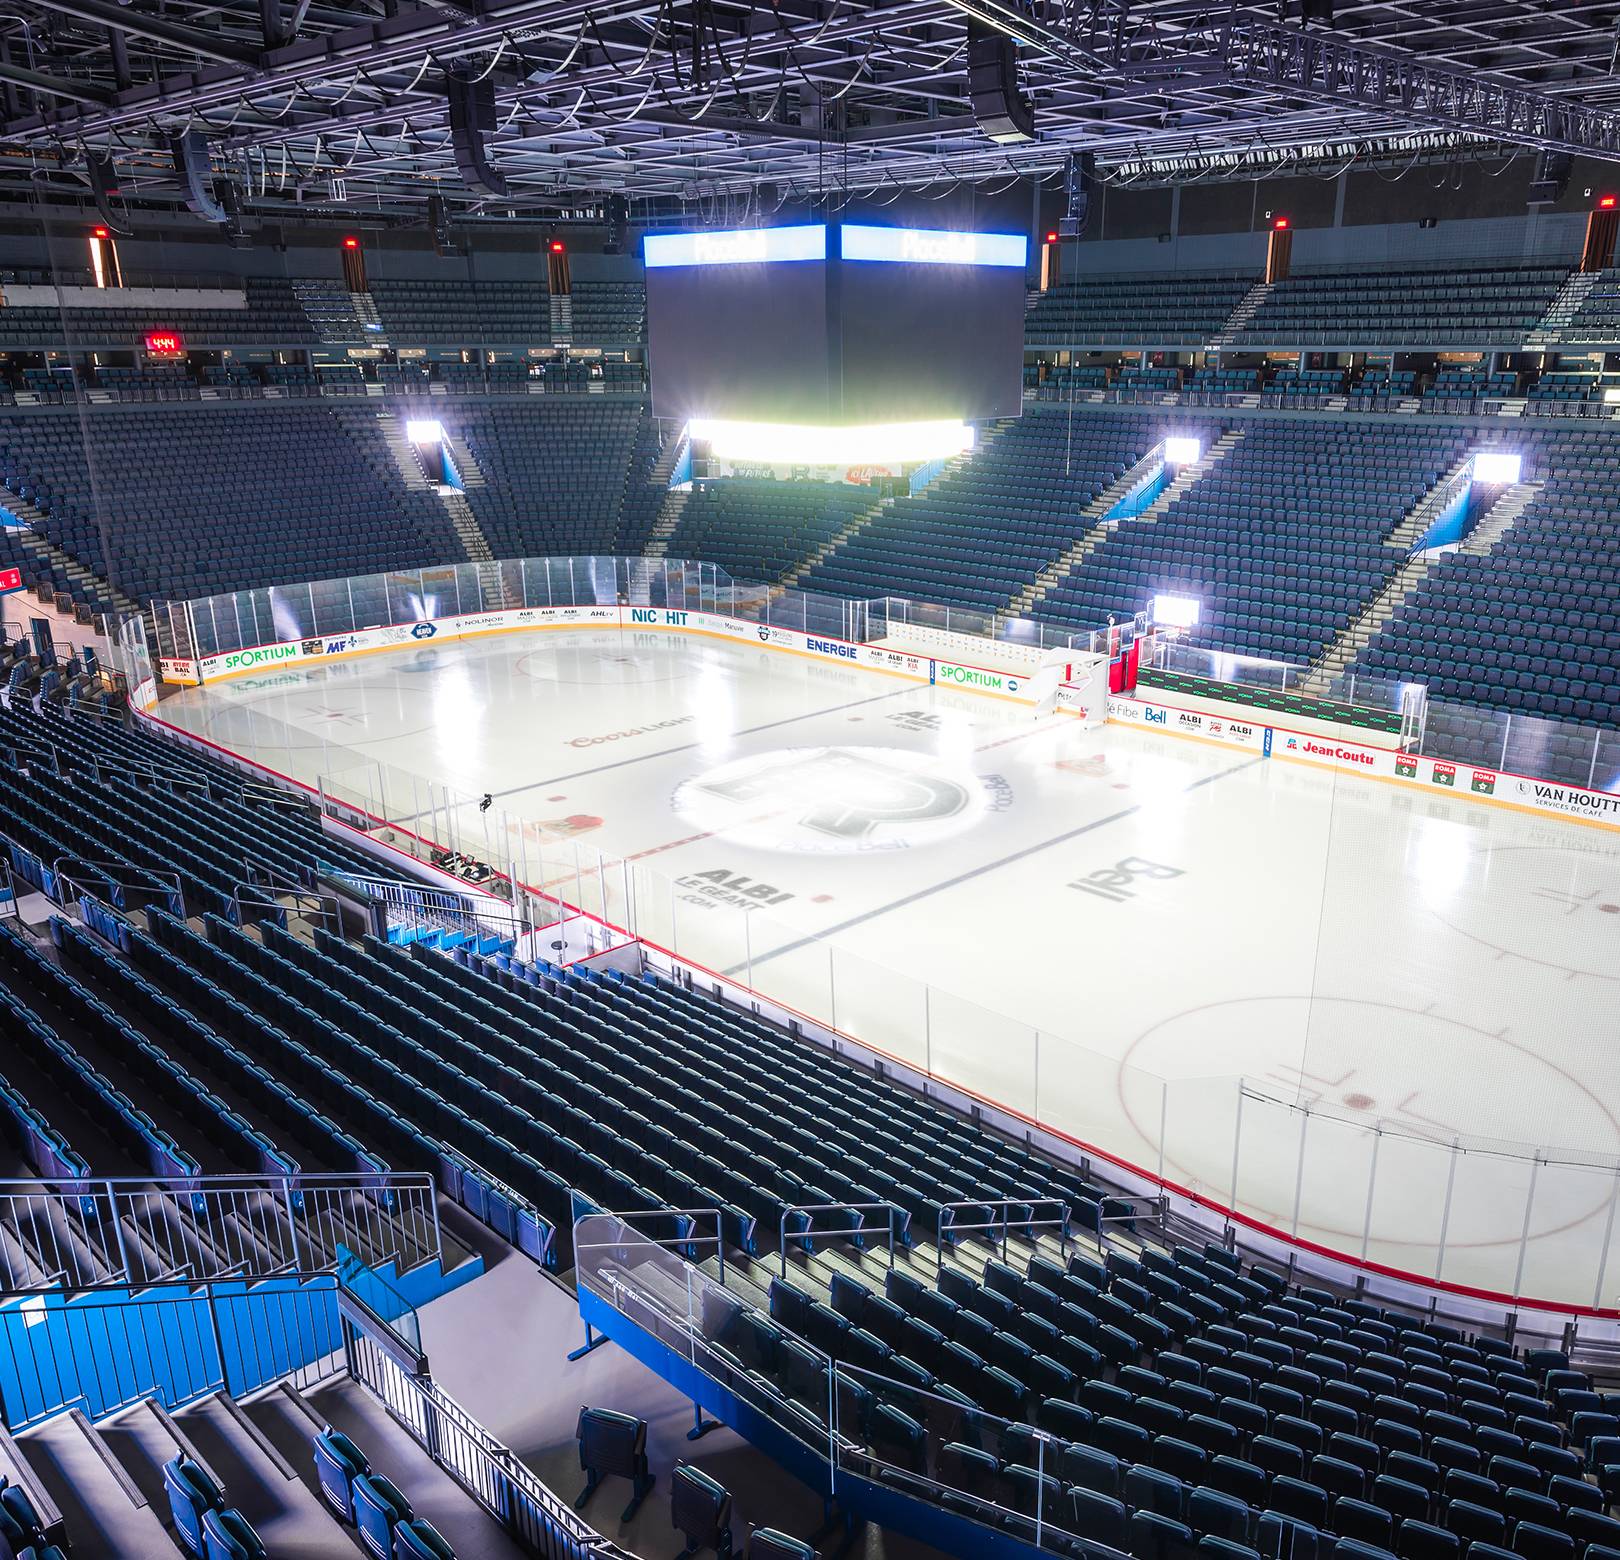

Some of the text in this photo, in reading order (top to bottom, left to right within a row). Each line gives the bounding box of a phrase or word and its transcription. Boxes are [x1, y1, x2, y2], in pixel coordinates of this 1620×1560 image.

[464, 616, 504, 626] NOLINOR
[632, 609, 688, 626] NIC HIT
[202, 658, 217, 667] ALBI
[225, 646, 296, 669] SPORTIUM
[888, 654, 903, 662] ALBI
[941, 666, 1002, 689] SPORTIUM
[1117, 704, 1138, 719] Fibe
[1145, 707, 1166, 724] Bell
[1179, 713, 1201, 724] ALBI
[1229, 725, 1252, 735] ALBI
[1397, 757, 1416, 766] ROMA
[1435, 765, 1454, 774] ROMA
[1474, 772, 1494, 782] ROMA
[1535, 785, 1564, 801] VAN
[1535, 798, 1569, 811] SERVICES
[673, 875, 766, 912] LE GEANT
[693, 868, 796, 906] ALBI
